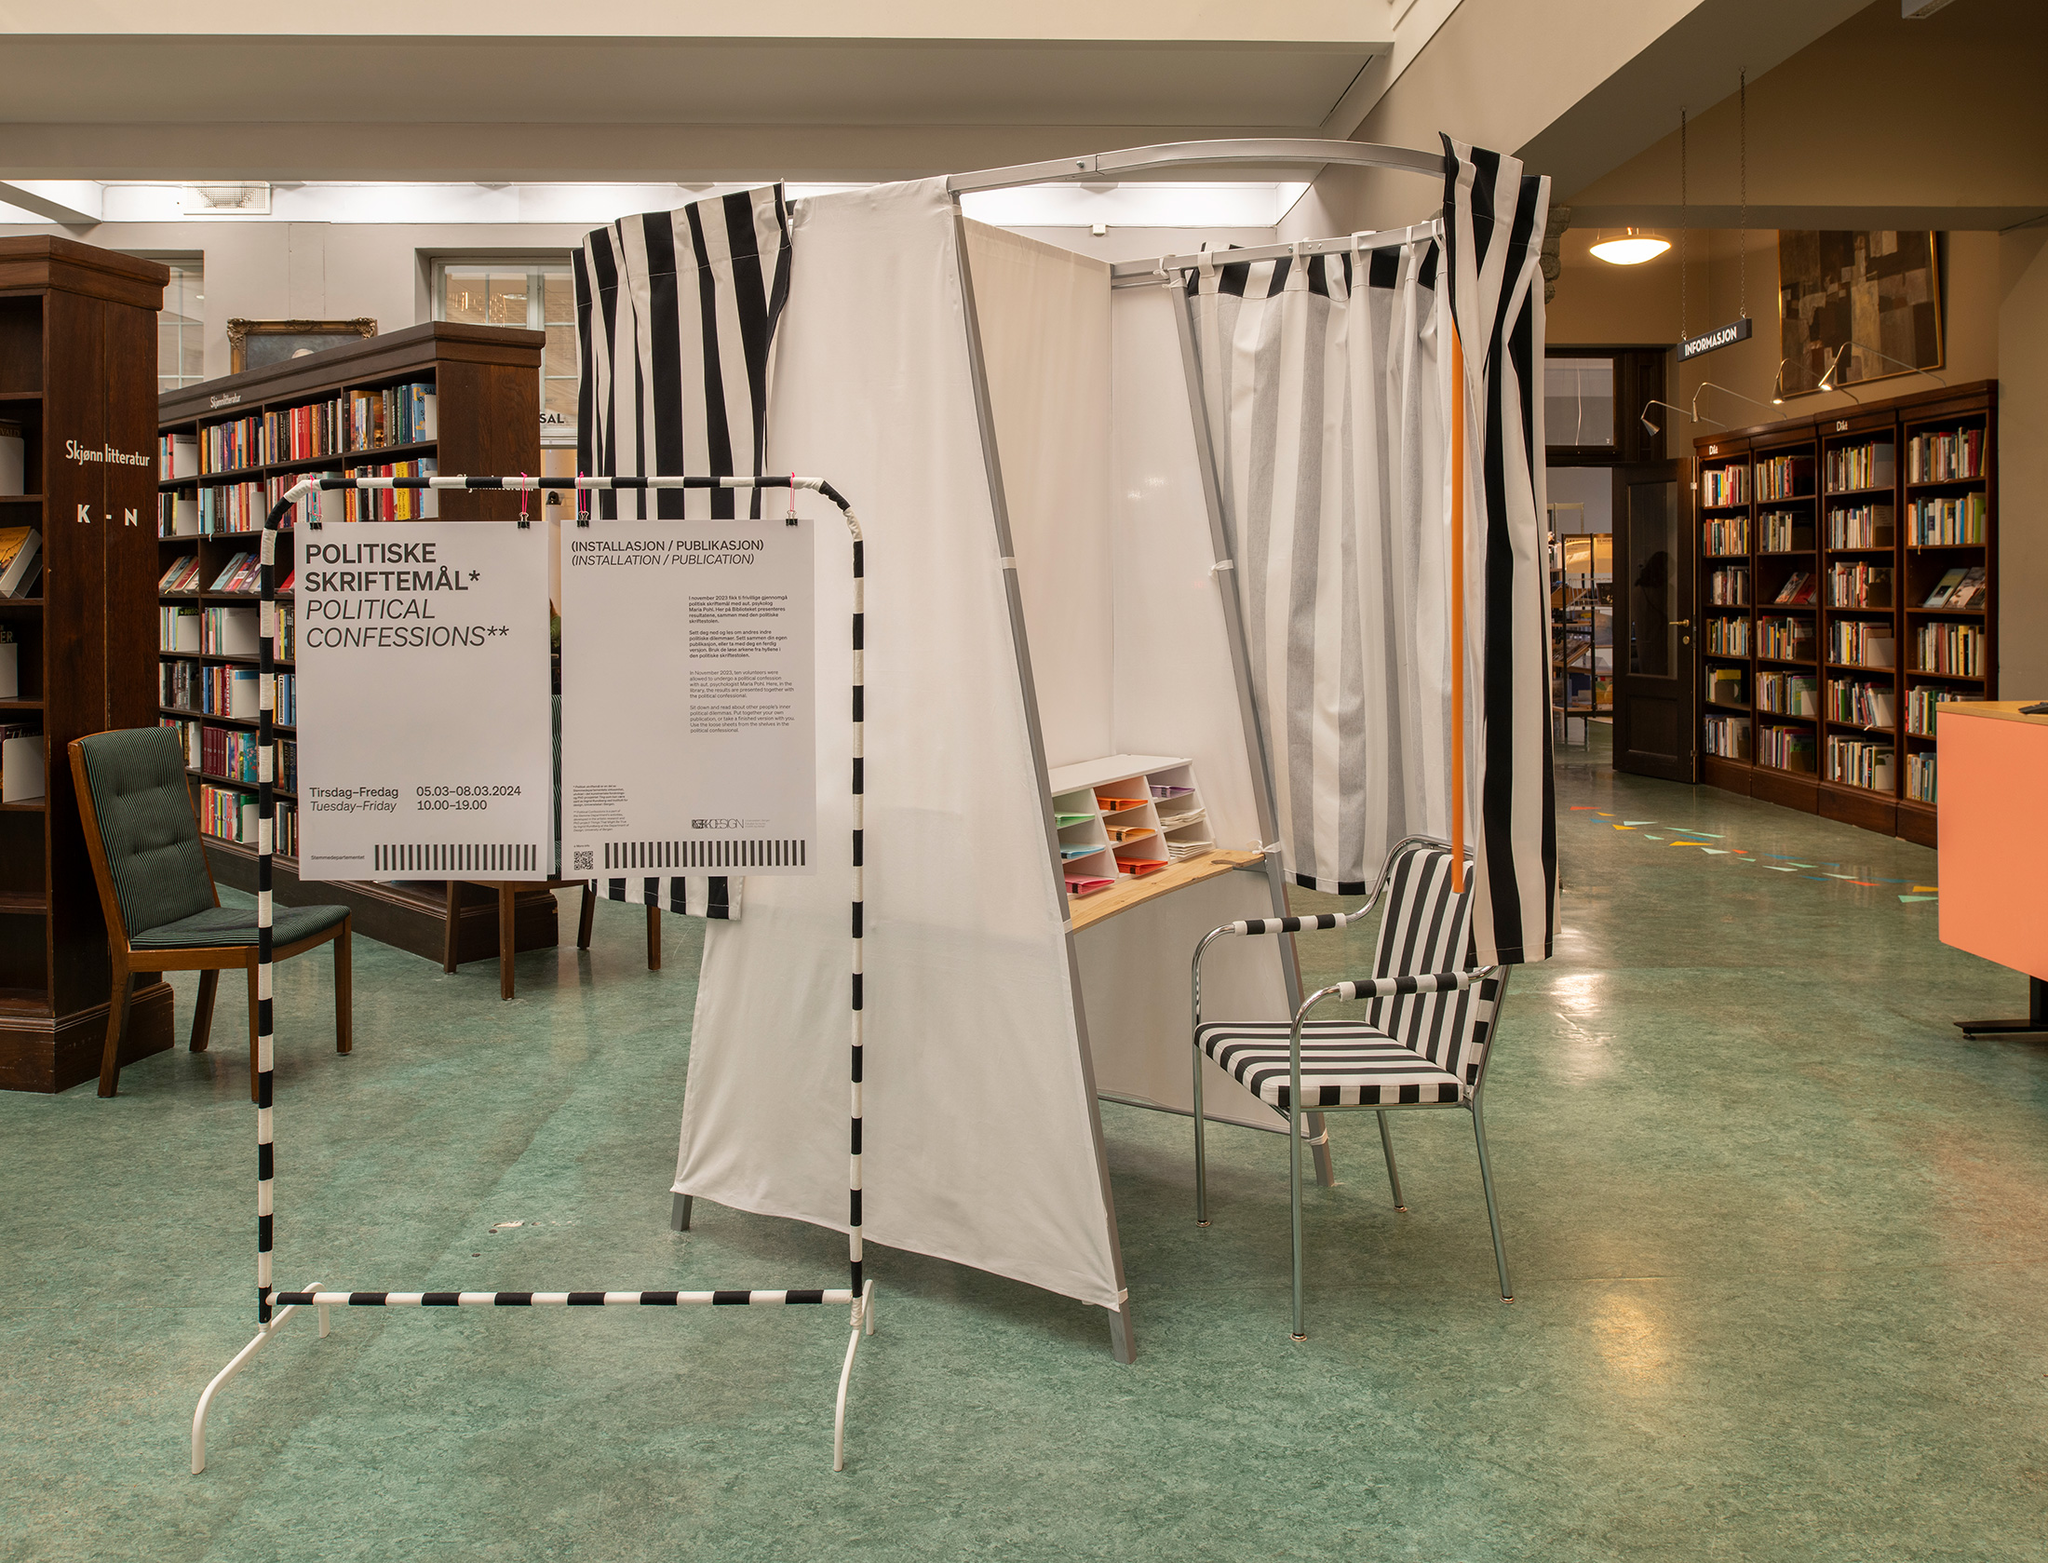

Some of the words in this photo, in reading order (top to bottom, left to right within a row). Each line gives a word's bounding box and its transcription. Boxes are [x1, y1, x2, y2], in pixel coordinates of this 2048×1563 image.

[1684, 326, 1737, 357] INFORMASJON
[77, 504, 91, 523] K
[124, 507, 138, 527] N
[305, 543, 437, 564] POLITISKE
[571, 541, 665, 552] (INSTALLASJON
[668, 540, 674, 552] /
[676, 539, 764, 551] PUBLIKASJON)
[571, 554, 661, 566] (INSTALLATION
[663, 554, 670, 566] /
[671, 553, 755, 565] PUBLICATION)
[306, 598, 436, 620] POLITICAL
[309, 787, 399, 799] Tirsdag–Fredag
[416, 785, 522, 797] 05.03–08.03.2024
[310, 801, 397, 813] Tuesday–Friday
[416, 799, 488, 811] 10.00–19.00
